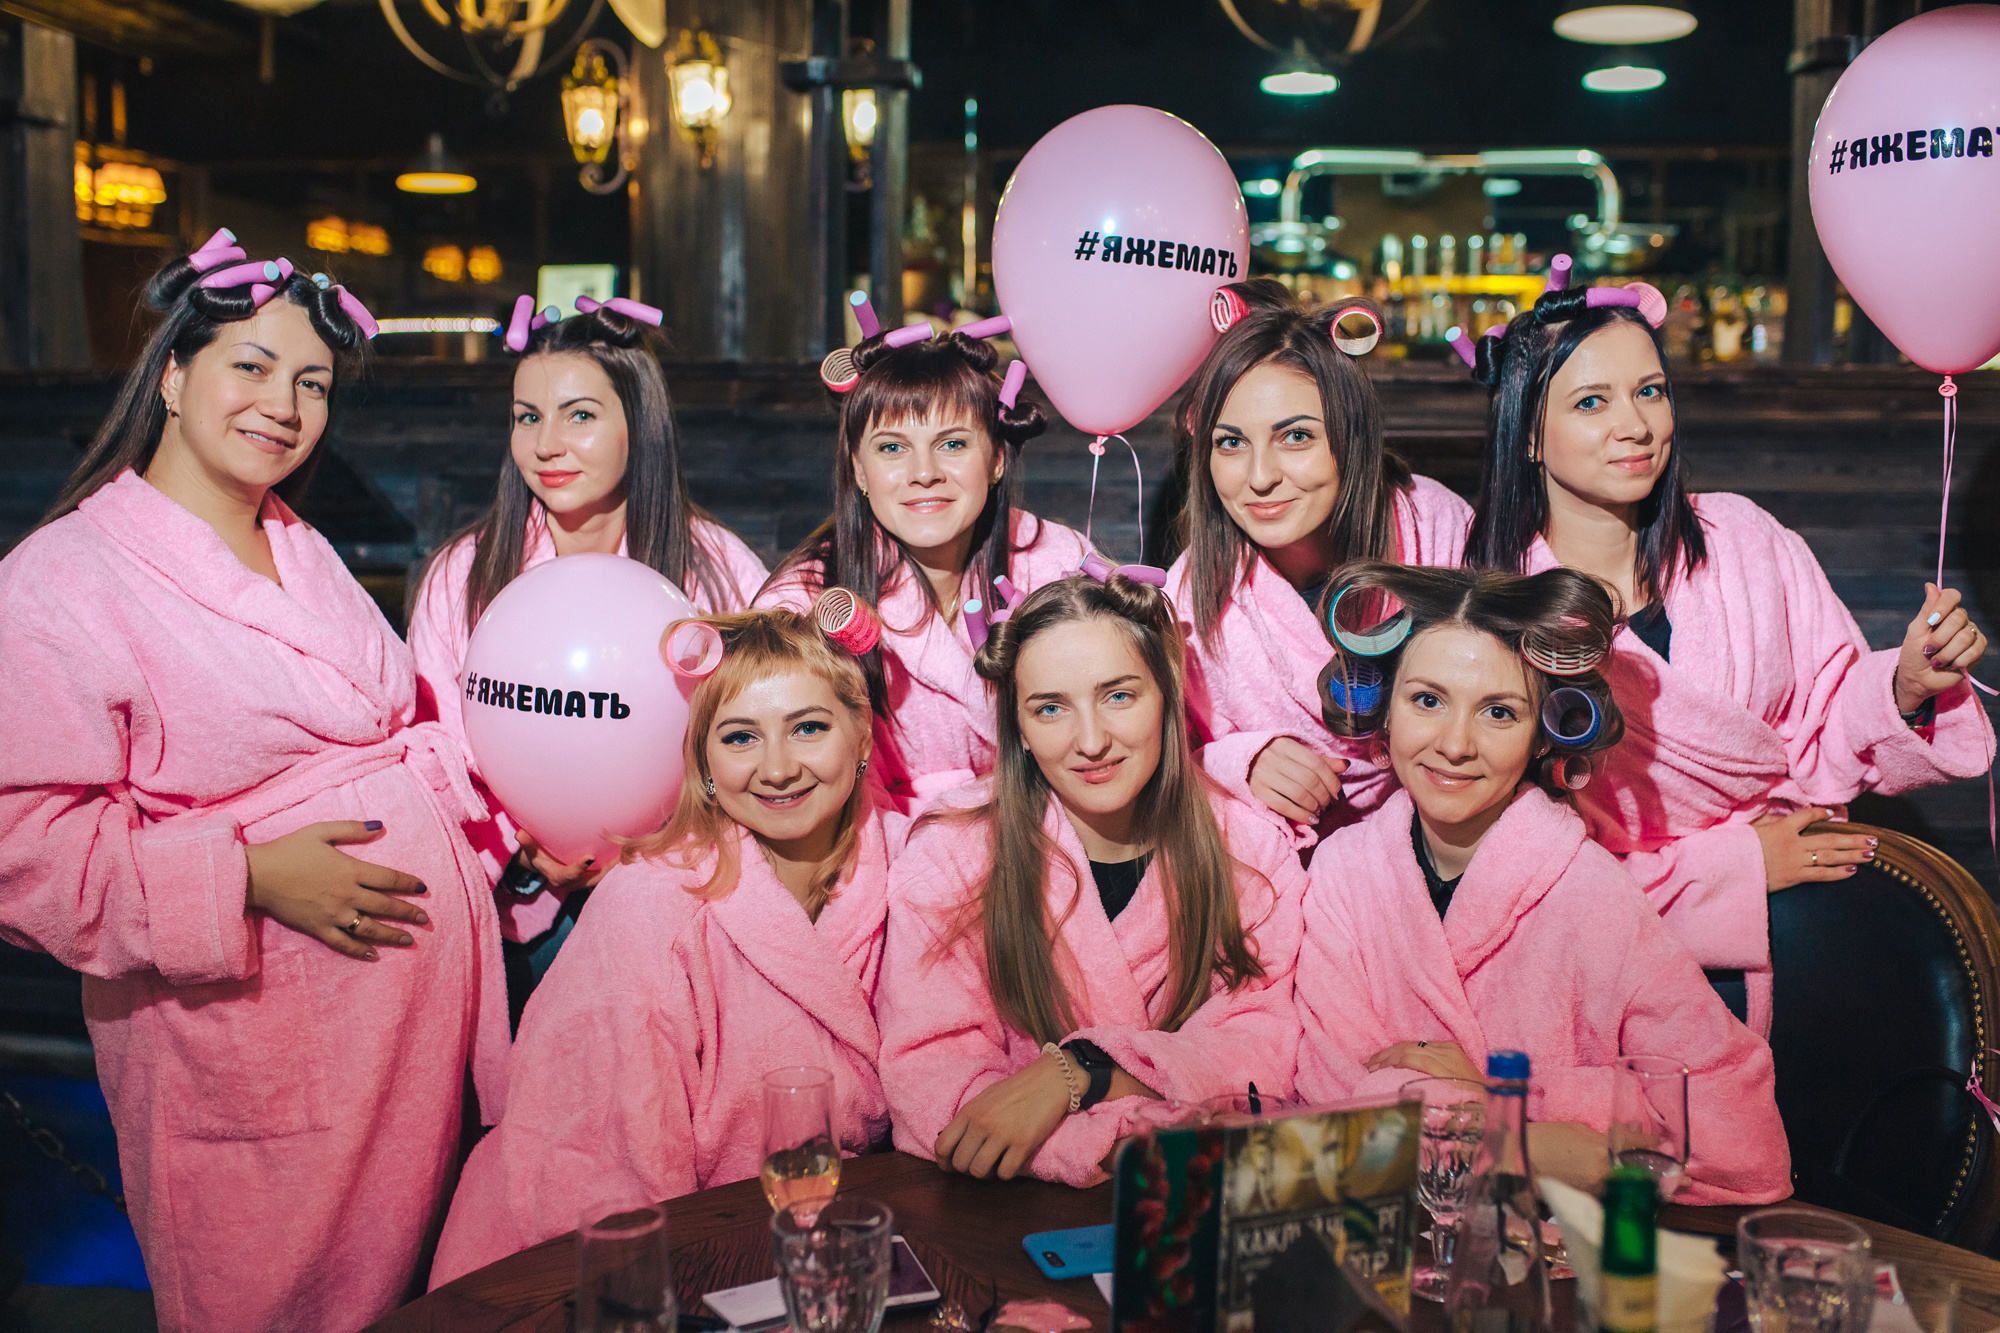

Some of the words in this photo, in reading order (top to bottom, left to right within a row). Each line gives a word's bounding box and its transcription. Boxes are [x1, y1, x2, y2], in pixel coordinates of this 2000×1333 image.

[1829, 126, 2000, 175] #ЯЖЕМА
[1074, 230, 1238, 279] #ЯЖЕМАТЬ
[465, 671, 631, 720] #ЯЖЕМАТЬ
